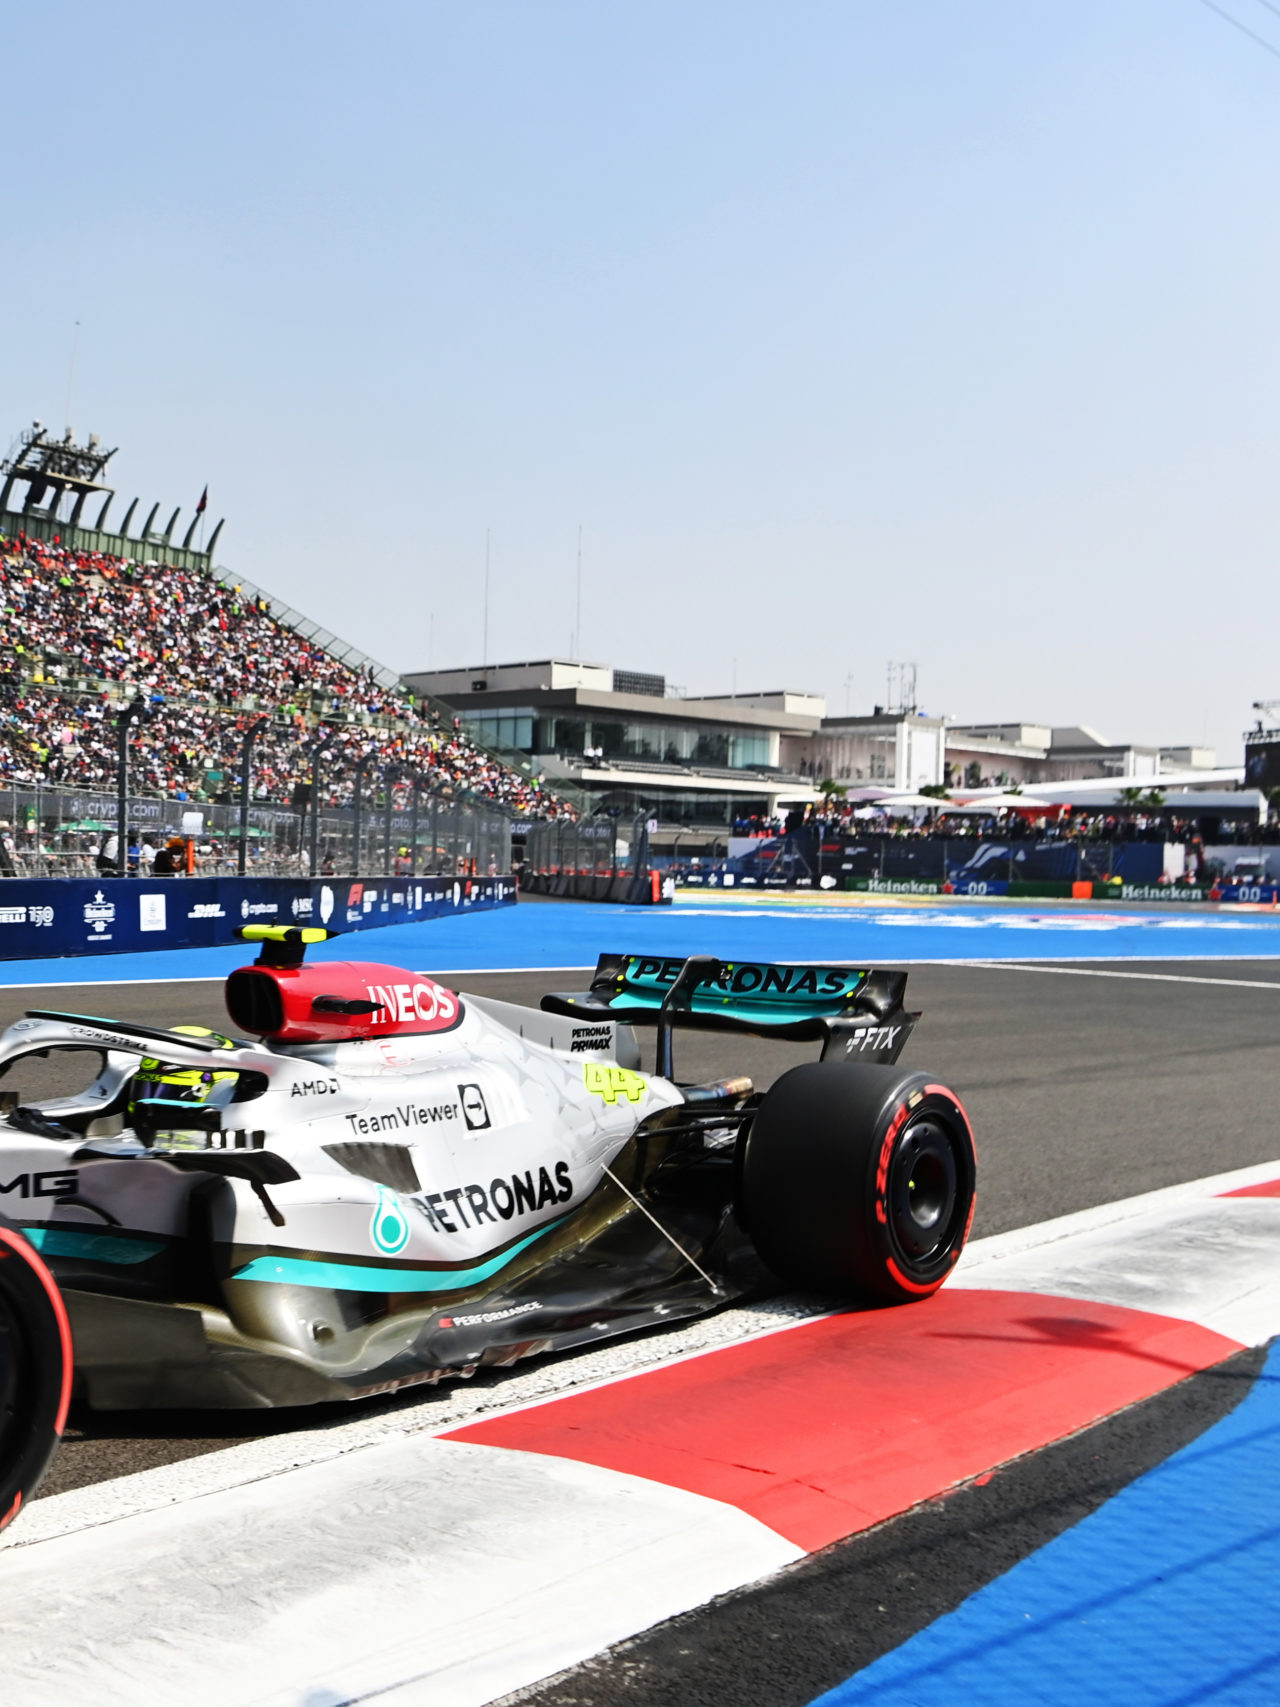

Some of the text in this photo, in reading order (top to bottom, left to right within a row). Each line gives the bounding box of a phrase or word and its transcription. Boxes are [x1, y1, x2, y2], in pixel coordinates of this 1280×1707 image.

[867, 879, 938, 894] Heineken
[1121, 885, 1202, 900] Heineken
[366, 983, 455, 1024] INEOS
[572, 1026, 611, 1039] PETRONAS
[863, 1026, 903, 1050] FTX
[571, 1036, 613, 1052] PRIMAX
[291, 1079, 328, 1098] AMD
[584, 1063, 646, 1104] 44
[345, 1104, 458, 1136] TeamViewer
[453, 1301, 543, 1328] PERFORMANCE
